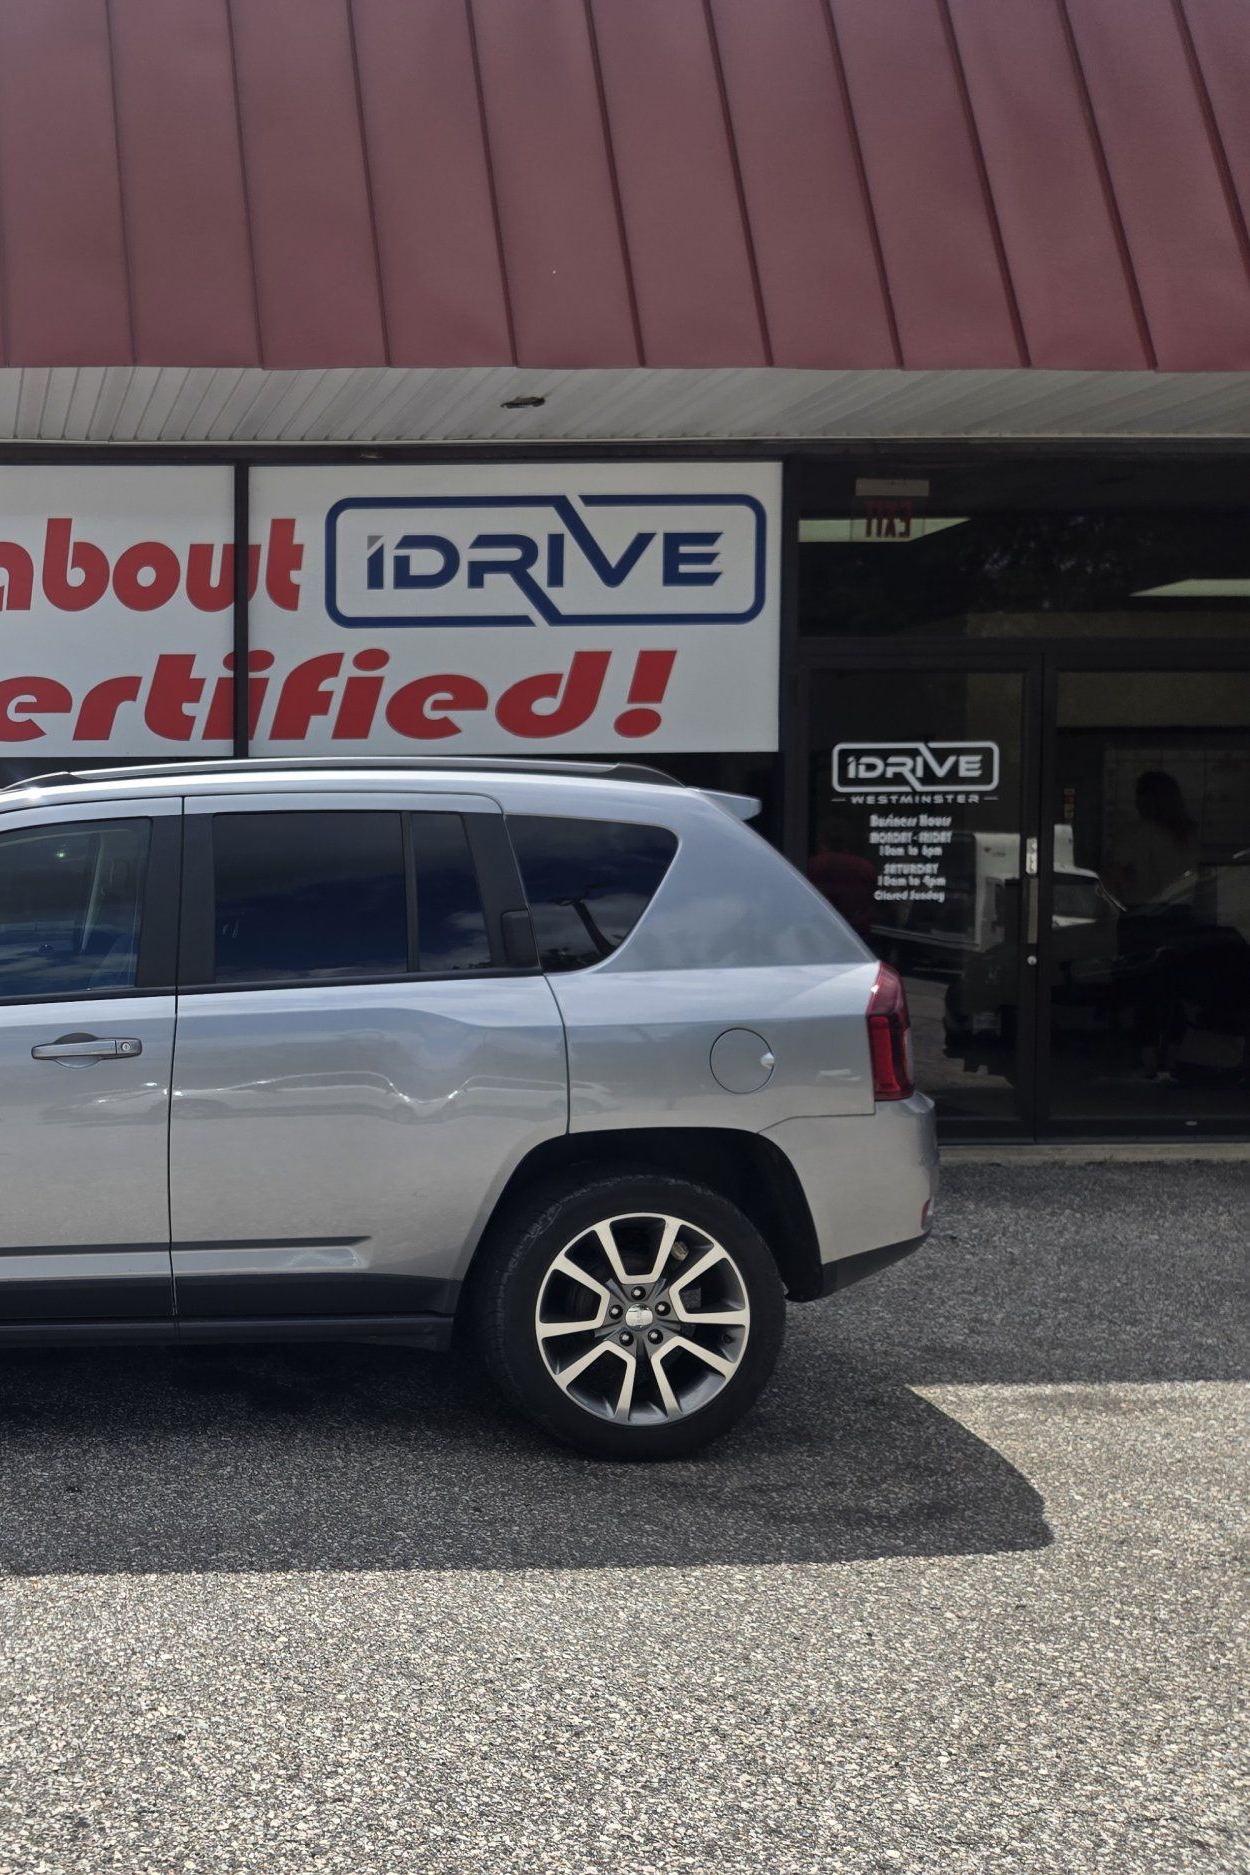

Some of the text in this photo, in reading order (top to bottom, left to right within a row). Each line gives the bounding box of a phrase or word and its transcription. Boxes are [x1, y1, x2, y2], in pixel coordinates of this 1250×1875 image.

[850, 794, 980, 805] WESTMINSTER
[869, 813, 952, 828] Business Hours
[907, 845, 919, 856] to
[883, 863, 939, 875] SATURDAY
[908, 875, 921, 887] to
[874, 889, 946, 903] Closed Sunday
